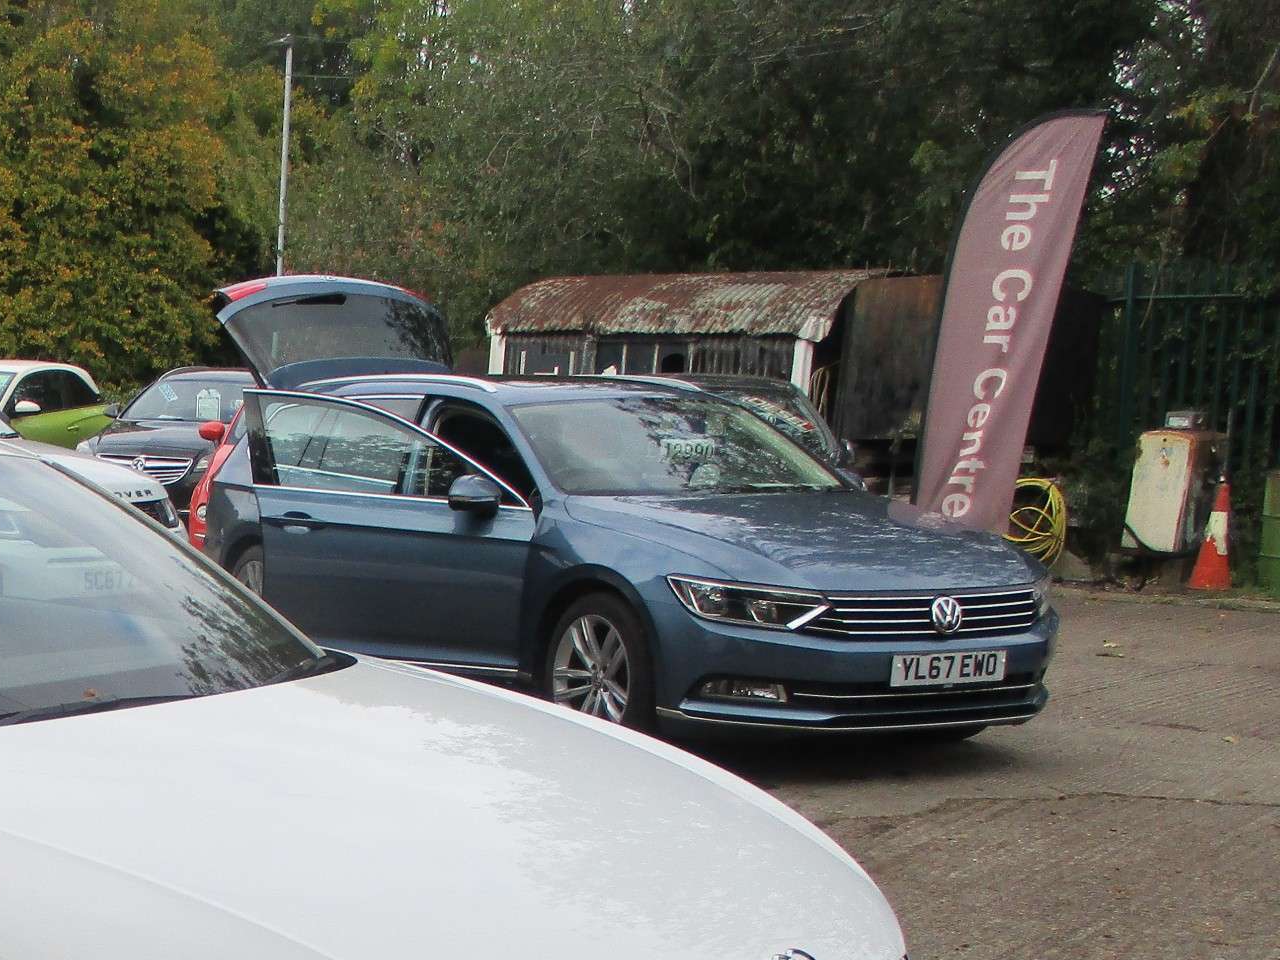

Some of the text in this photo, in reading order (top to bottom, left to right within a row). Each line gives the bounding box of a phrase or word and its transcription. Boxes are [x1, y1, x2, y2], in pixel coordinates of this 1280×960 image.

[941, 158, 1057, 519] The Car Centre
[902, 653, 998, 681] YL67 EWO
